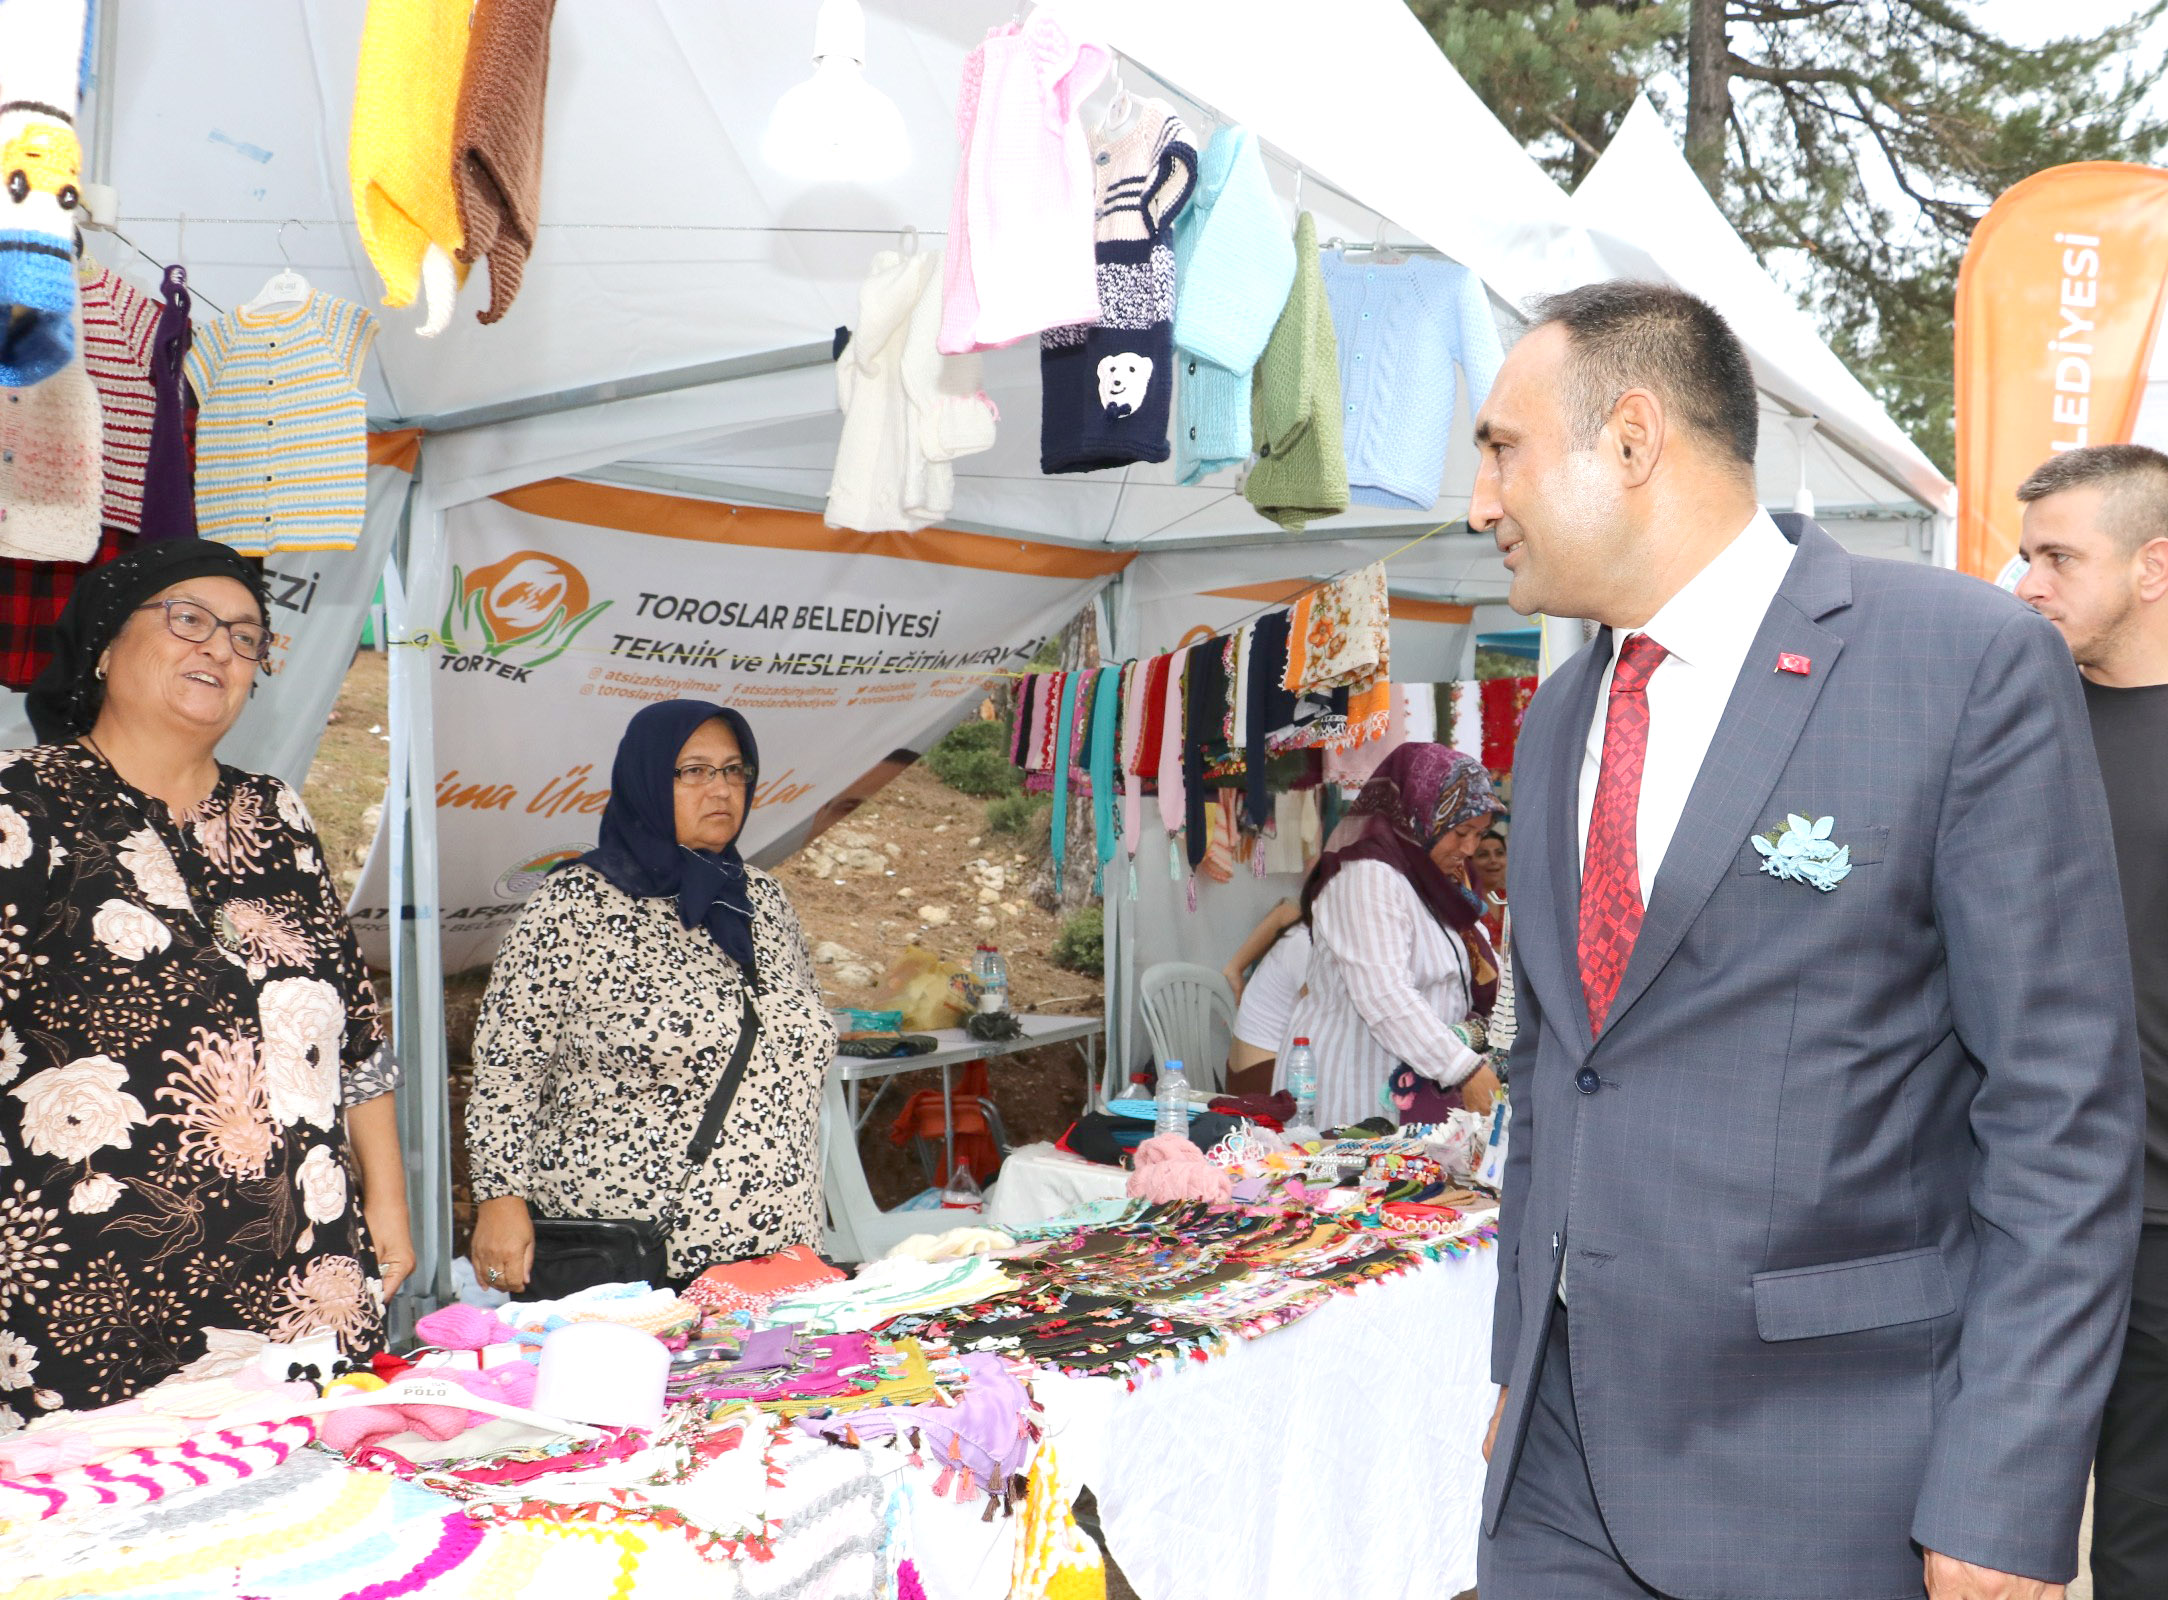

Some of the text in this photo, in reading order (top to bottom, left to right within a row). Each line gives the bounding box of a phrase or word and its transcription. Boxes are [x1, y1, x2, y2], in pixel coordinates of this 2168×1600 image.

[2049, 232, 2101, 452] LEDİYESİ
[262, 568, 320, 614] EZİ
[636, 592, 941, 639] TOROSLAR BELEDİYESİ
[439, 654, 533, 684] TORTEK
[610, 634, 728, 669] TEKNİK
[730, 653, 763, 672] ve
[767, 650, 884, 676] MESLEKİ
[878, 650, 958, 674] EĞİTİM
[525, 763, 612, 818] Üre
[403, 1388, 447, 1397] POLO
